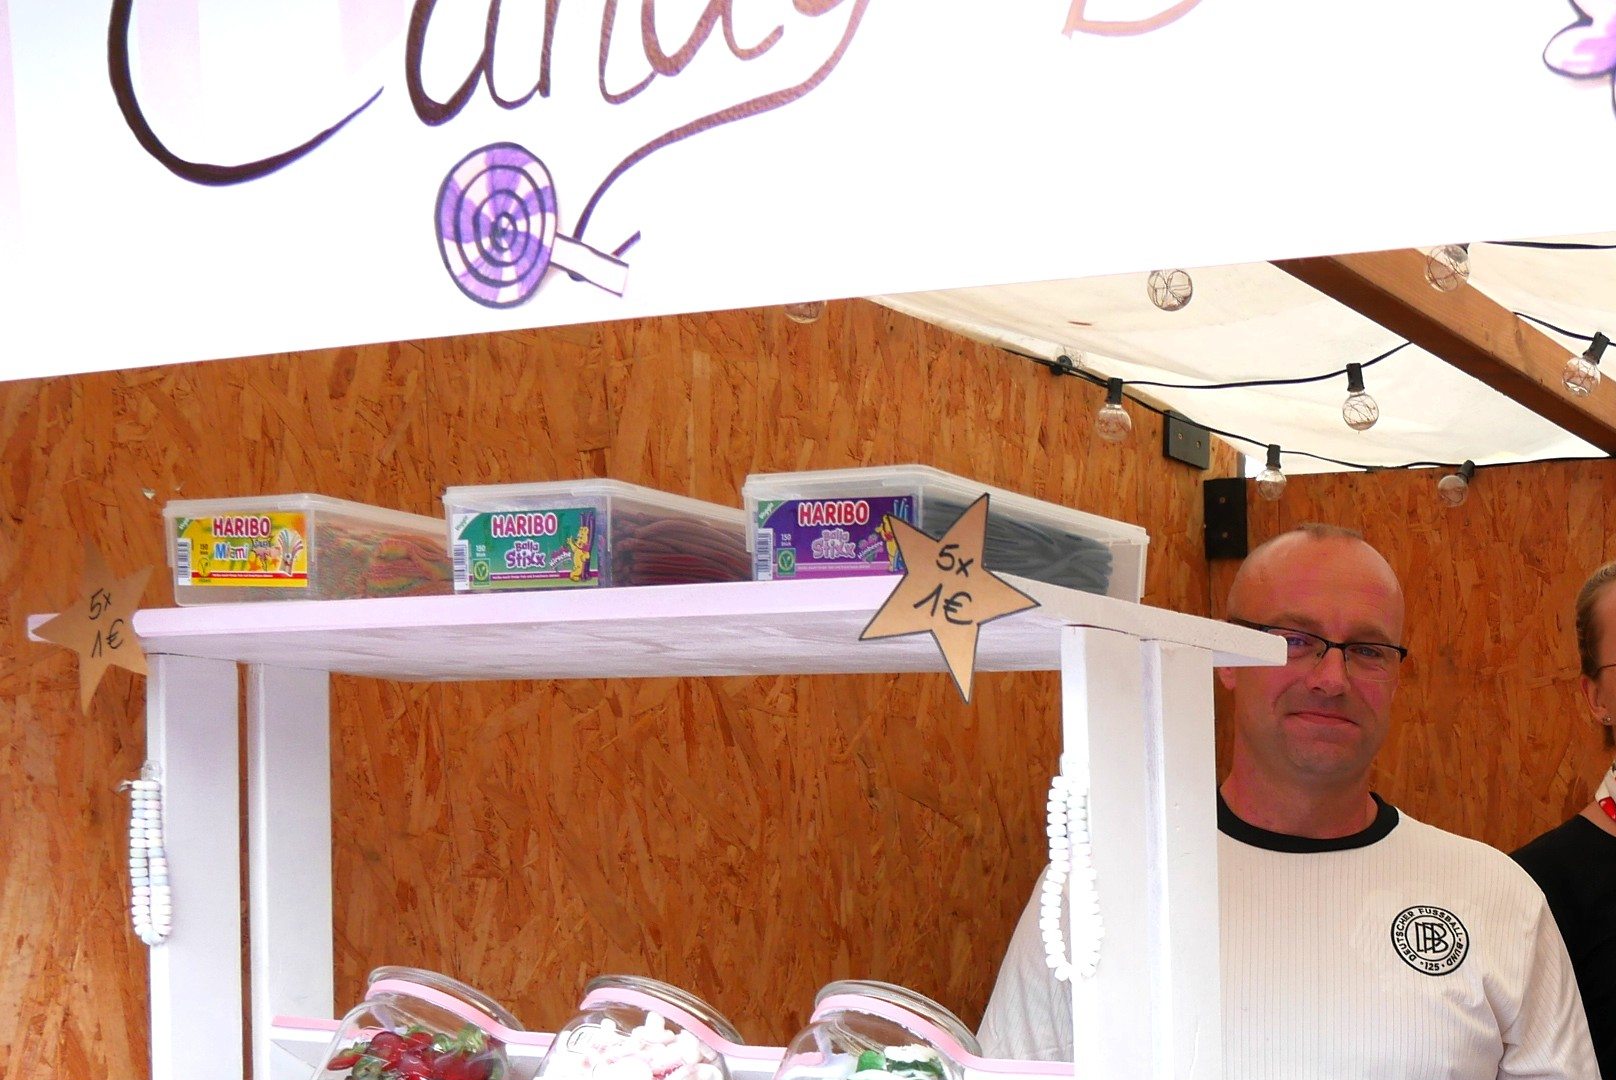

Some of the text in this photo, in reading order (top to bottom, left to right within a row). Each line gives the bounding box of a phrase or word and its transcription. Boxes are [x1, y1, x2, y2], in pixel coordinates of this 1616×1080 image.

[212, 517, 271, 537] HARIBO
[491, 513, 557, 538] HARIBO
[798, 501, 869, 526] HARIBO
[935, 543, 974, 578] 5x
[88, 587, 113, 621] 5x
[913, 584, 974, 625] 1€
[91, 619, 125, 659] 1€
[1395, 910, 1417, 962] DEUTSCHER
